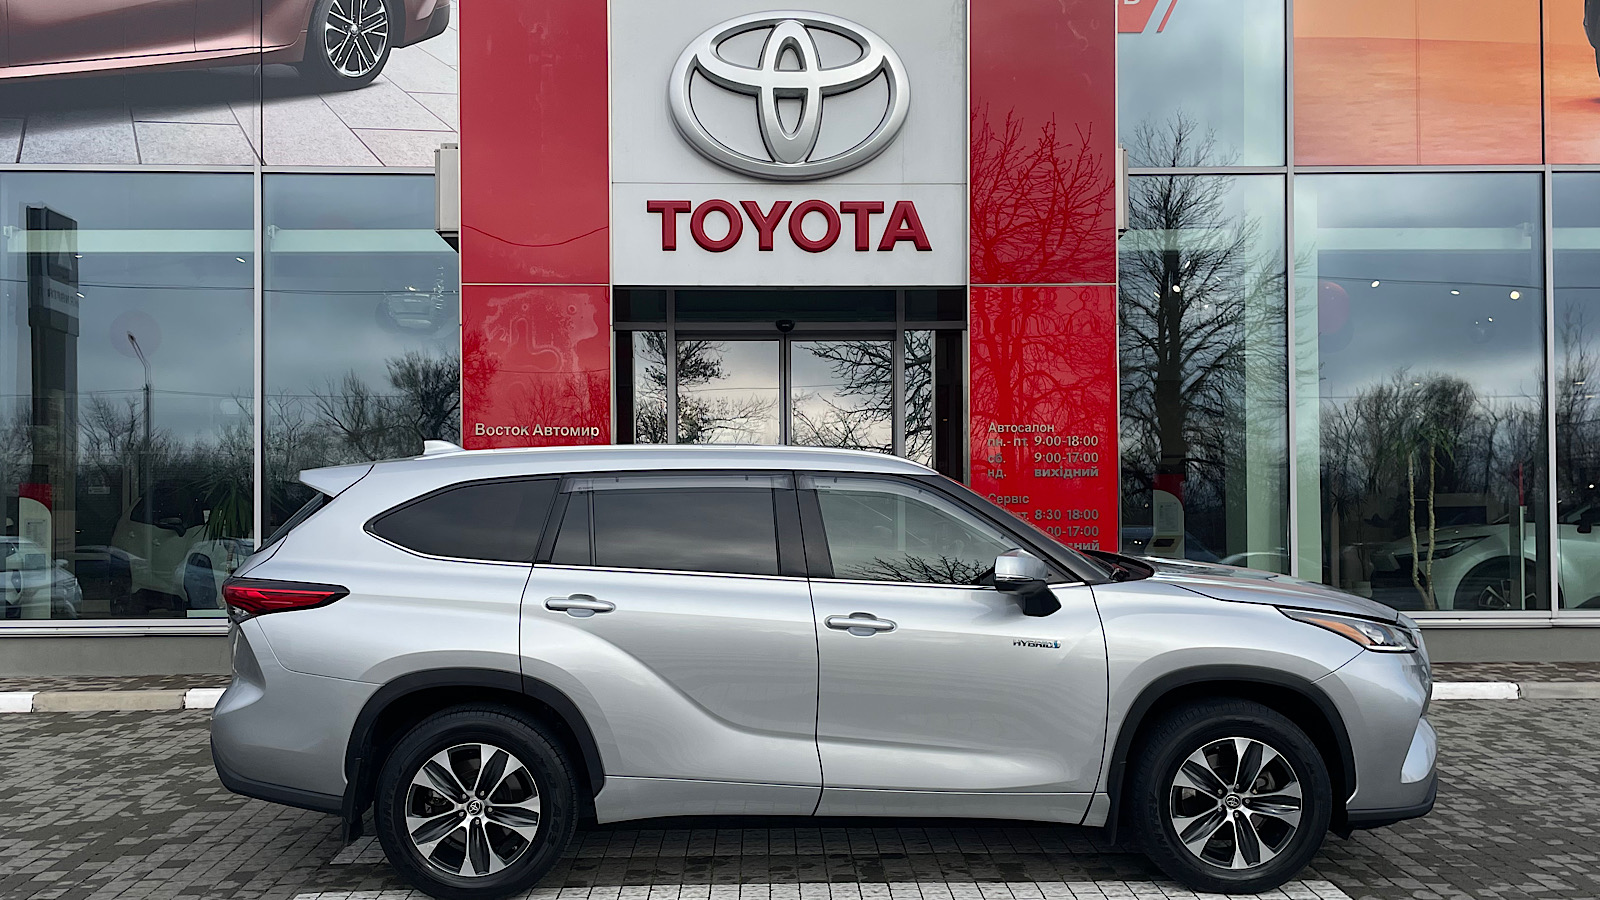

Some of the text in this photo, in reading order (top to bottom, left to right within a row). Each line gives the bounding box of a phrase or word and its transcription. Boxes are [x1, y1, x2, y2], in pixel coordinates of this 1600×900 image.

[647, 199, 932, 252] TOYOTA
[475, 423, 599, 439] Восток Автомир
[988, 422, 1054, 433] Автосалон
[987, 452, 1098, 463] сб. 9:00-17:00
[987, 466, 1099, 479] нд. вихідний
[1034, 509, 1061, 520] 8:30
[1067, 509, 1099, 520] 18:00
[1012, 639, 1053, 649] HYBRID
